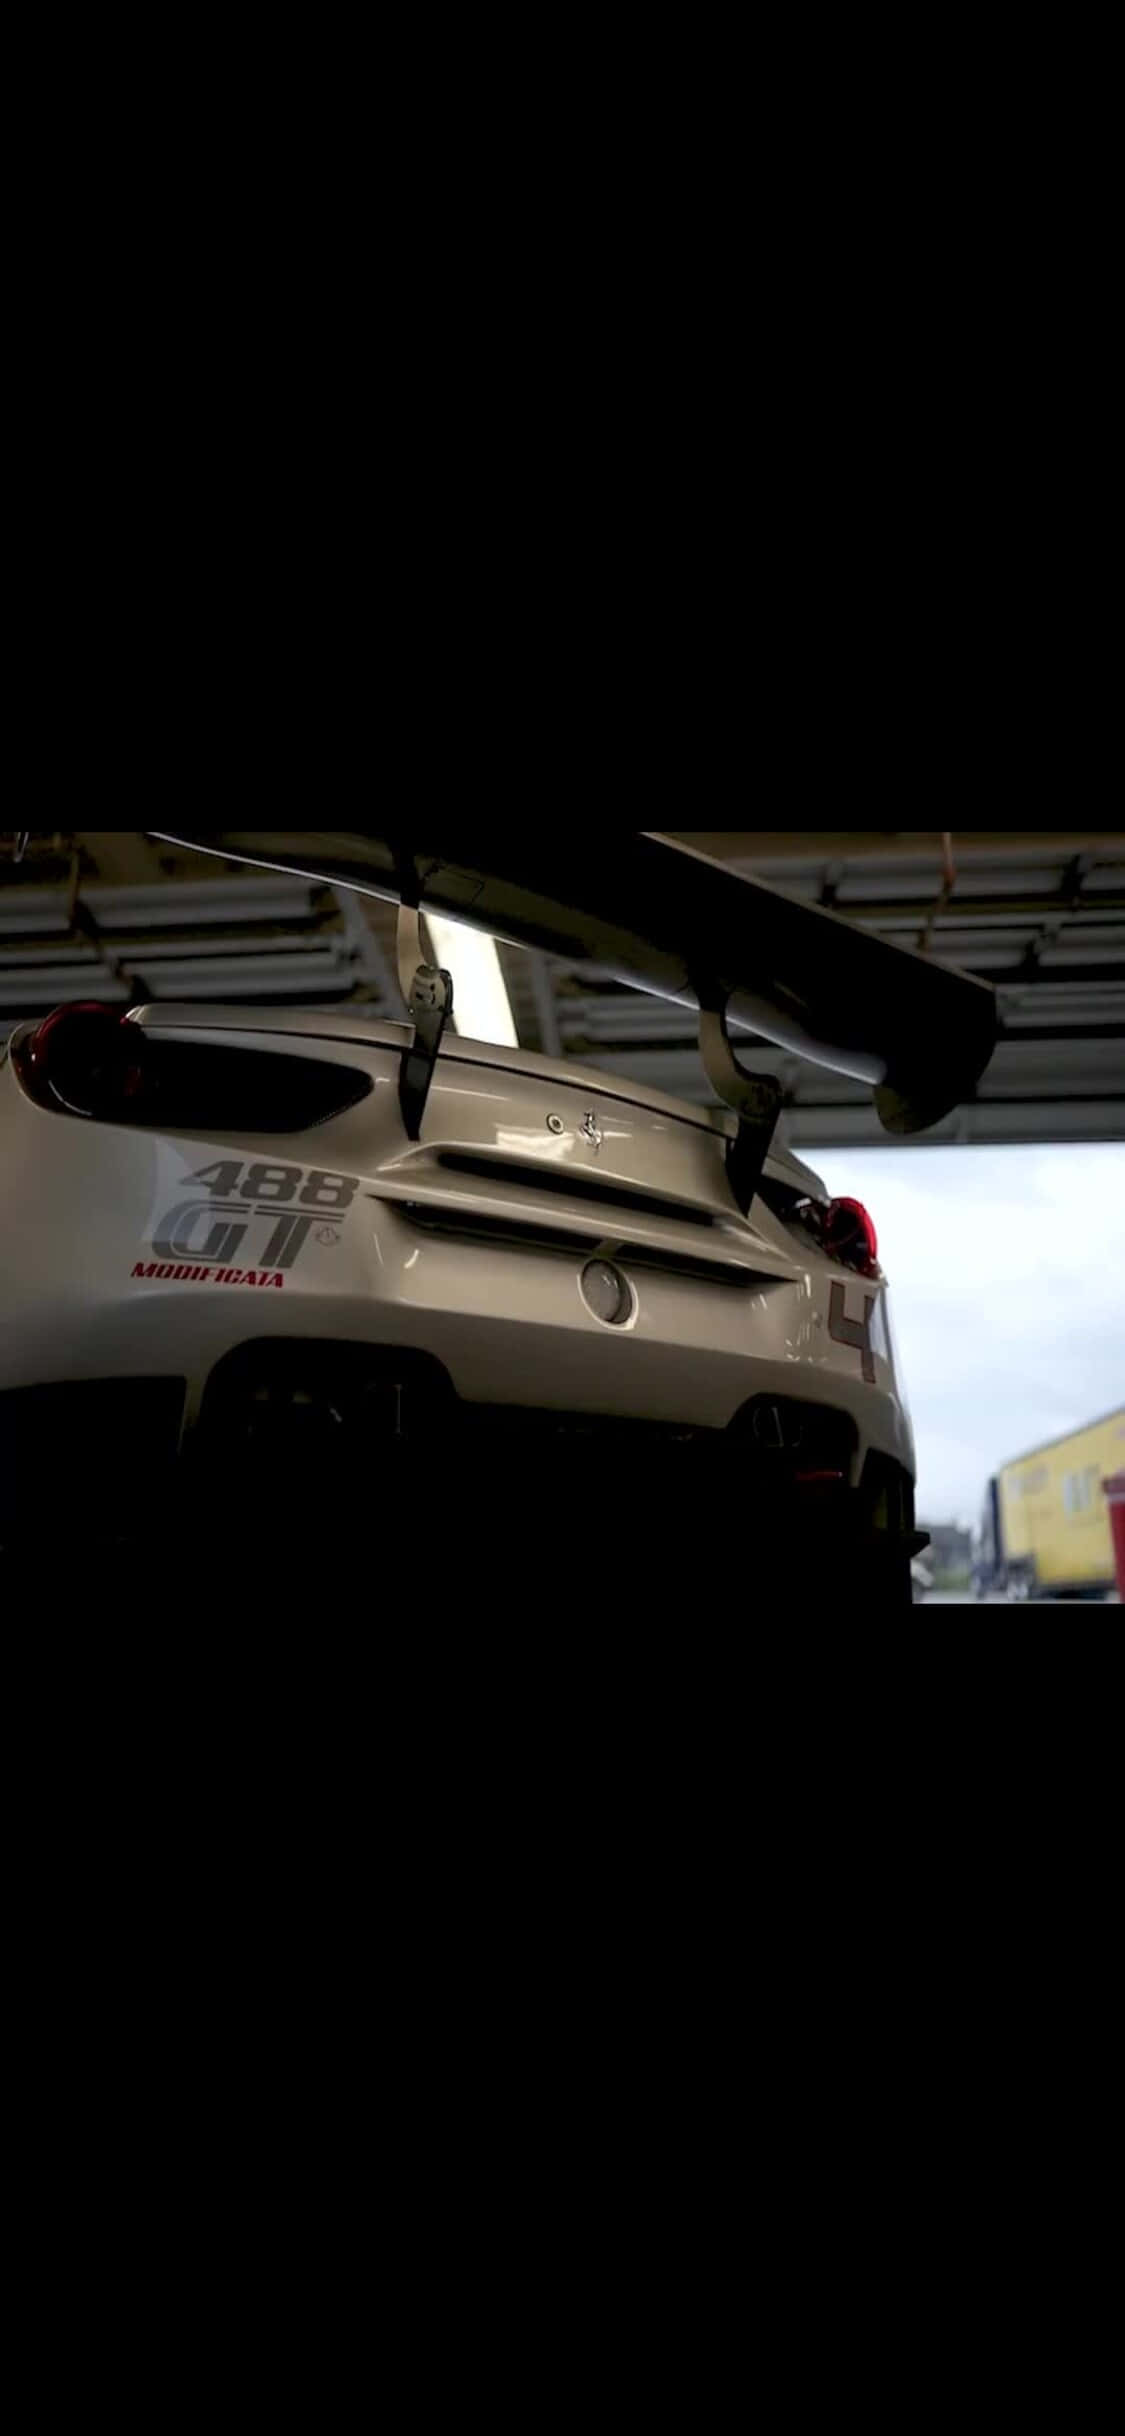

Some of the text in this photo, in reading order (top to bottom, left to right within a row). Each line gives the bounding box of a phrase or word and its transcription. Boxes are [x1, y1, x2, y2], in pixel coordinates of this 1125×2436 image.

[180, 1160, 360, 1208] 488
[152, 1201, 345, 1268] GT
[131, 1262, 283, 1288] MODIFICATA
[828, 1280, 876, 1384] 4
